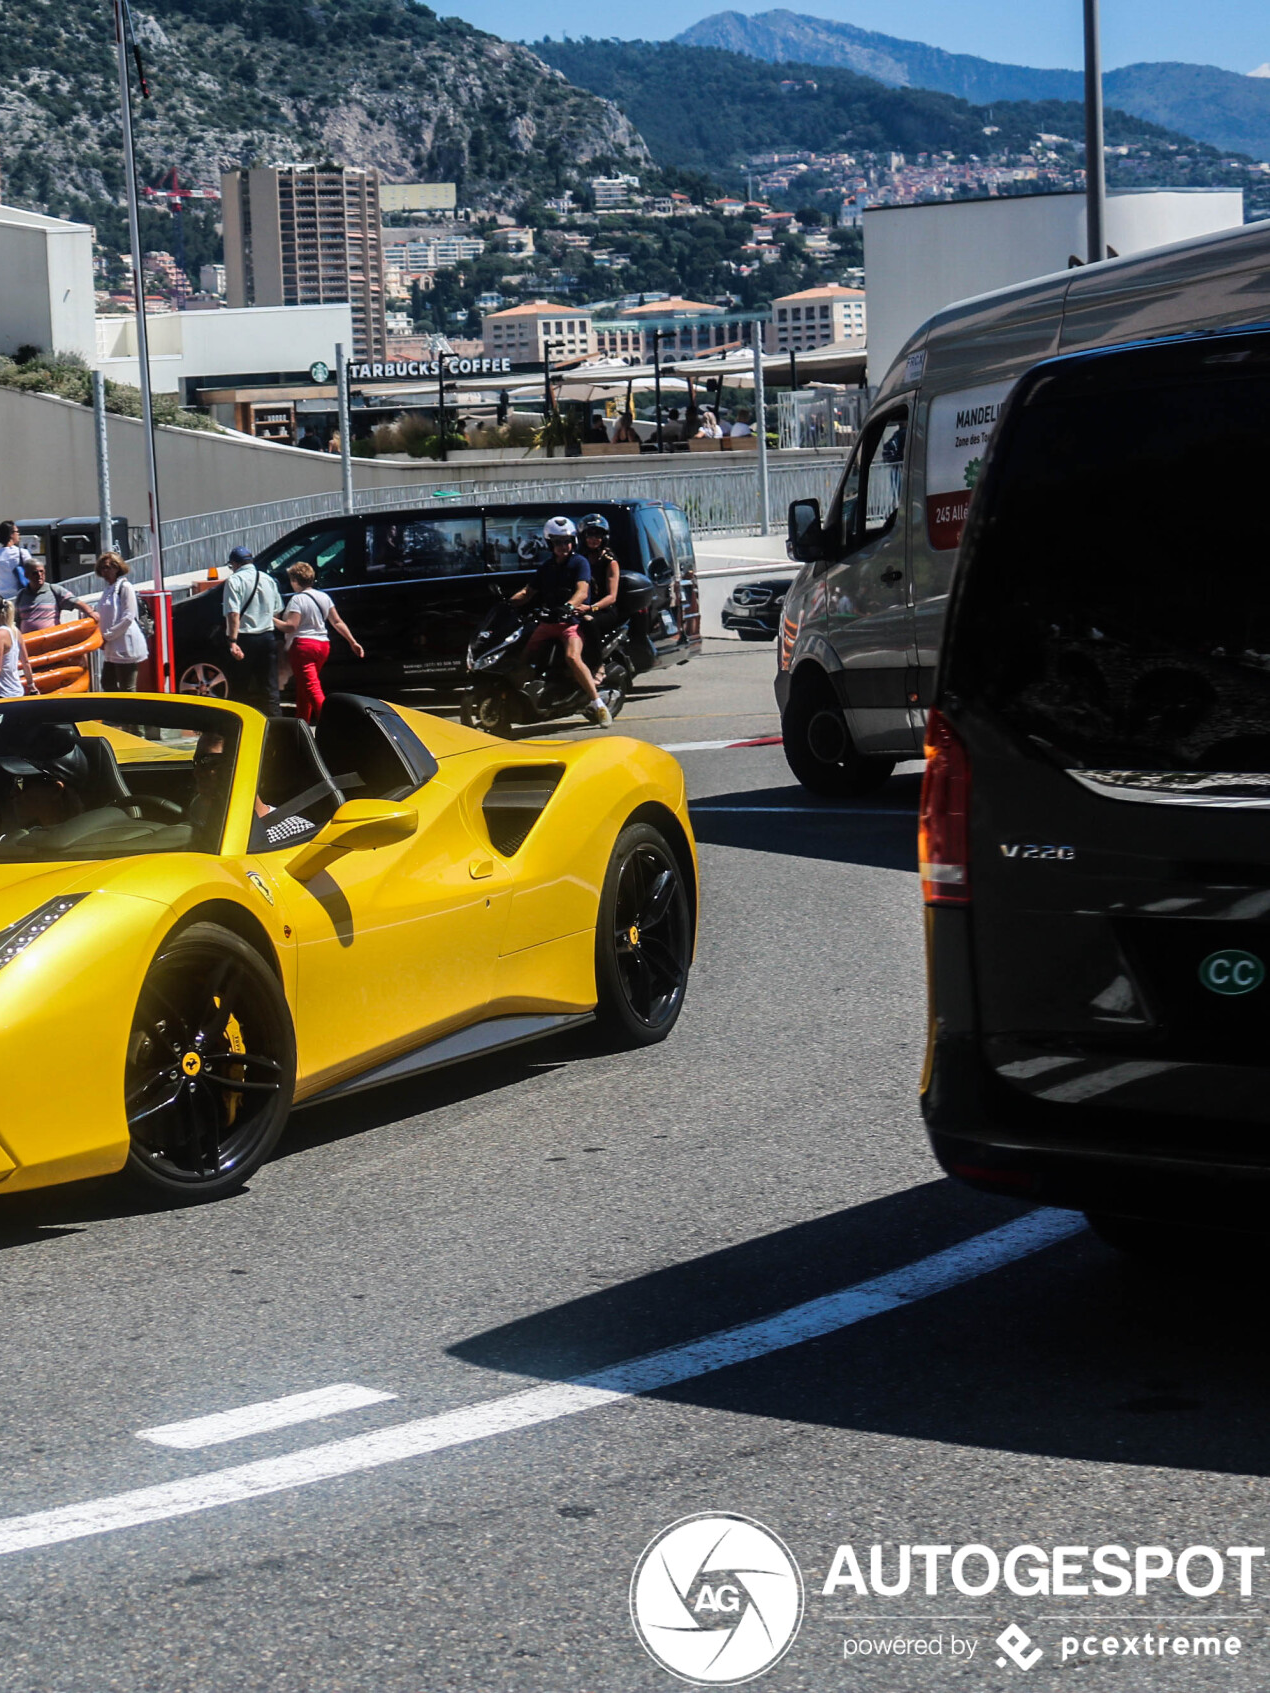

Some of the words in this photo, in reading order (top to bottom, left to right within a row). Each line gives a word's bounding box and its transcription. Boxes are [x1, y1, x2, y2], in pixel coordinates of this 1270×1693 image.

[349, 361, 440, 379] TARBUCKS
[449, 358, 511, 375] COFFEE
[955, 436, 969, 448] Zone
[970, 433, 980, 445] des
[936, 506, 950, 523] 245
[951, 502, 968, 521] Allé
[1208, 958, 1255, 986] CC
